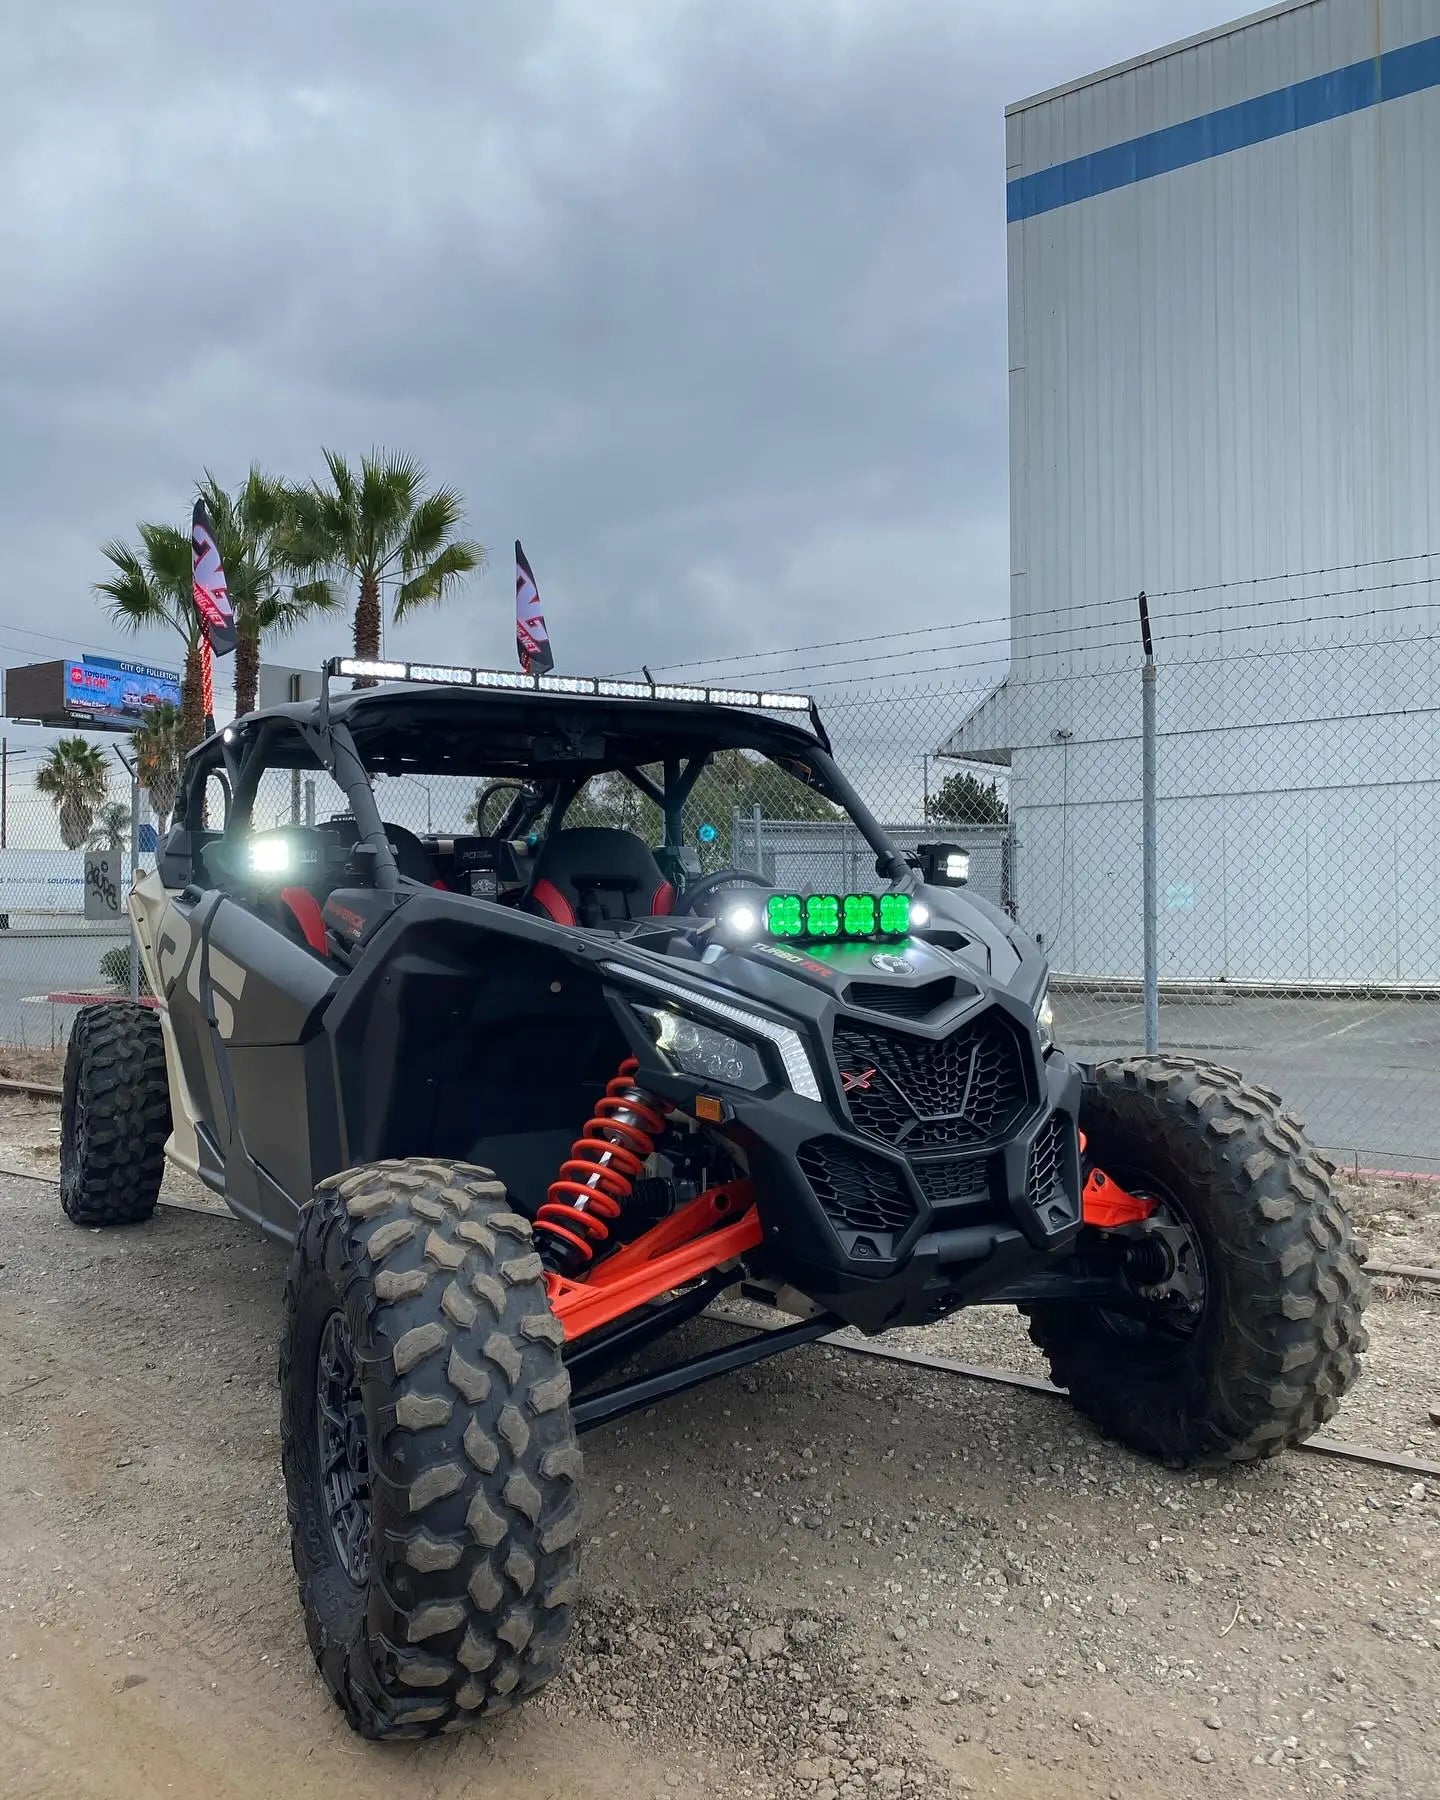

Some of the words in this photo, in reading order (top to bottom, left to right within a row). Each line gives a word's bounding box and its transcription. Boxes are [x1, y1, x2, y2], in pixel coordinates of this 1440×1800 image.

[120, 662, 134, 672] CITY
[135, 666, 145, 674] OF
[146, 668, 178, 681] FULLERTON
[752, 942, 803, 963] TURBO
